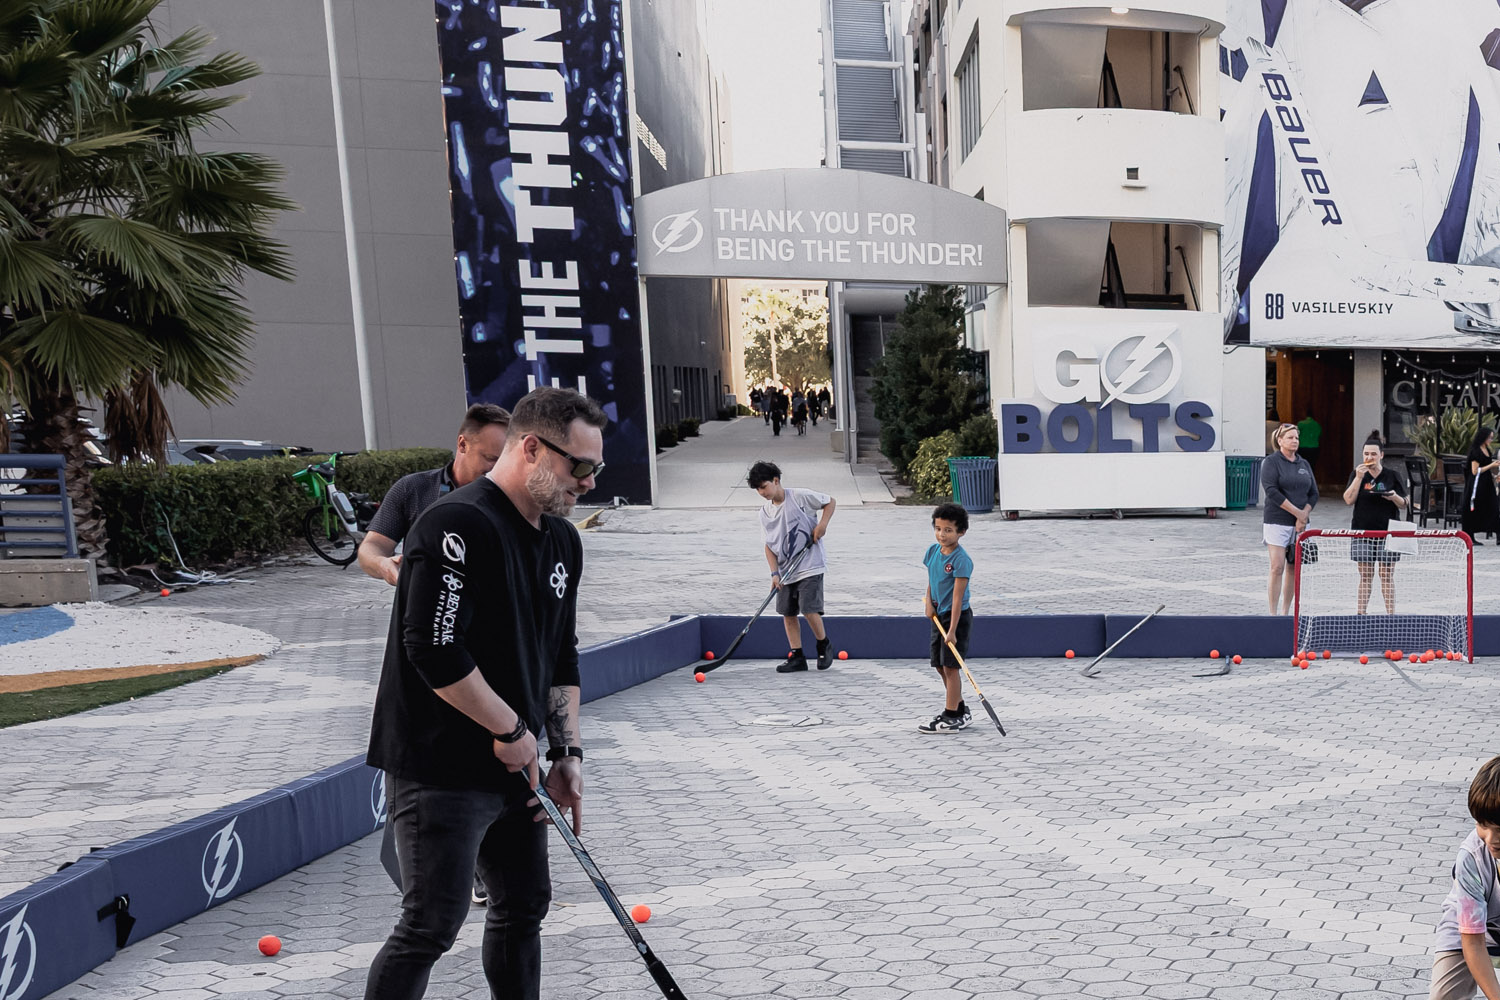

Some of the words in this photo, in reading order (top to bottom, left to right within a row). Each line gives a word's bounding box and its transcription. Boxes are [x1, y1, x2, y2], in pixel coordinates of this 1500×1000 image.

[713, 207, 805, 234] THANK
[810, 210, 859, 235] YOU
[867, 212, 917, 237] FOR
[717, 237, 795, 263] BEING
[801, 239, 850, 265] THE
[857, 241, 984, 267] THUNDER!
[518, 259, 584, 361] THE
[1265, 293, 1284, 320] 88
[1292, 301, 1394, 314] VASILEVSKIY
[1001, 401, 1216, 454] BOLTS
